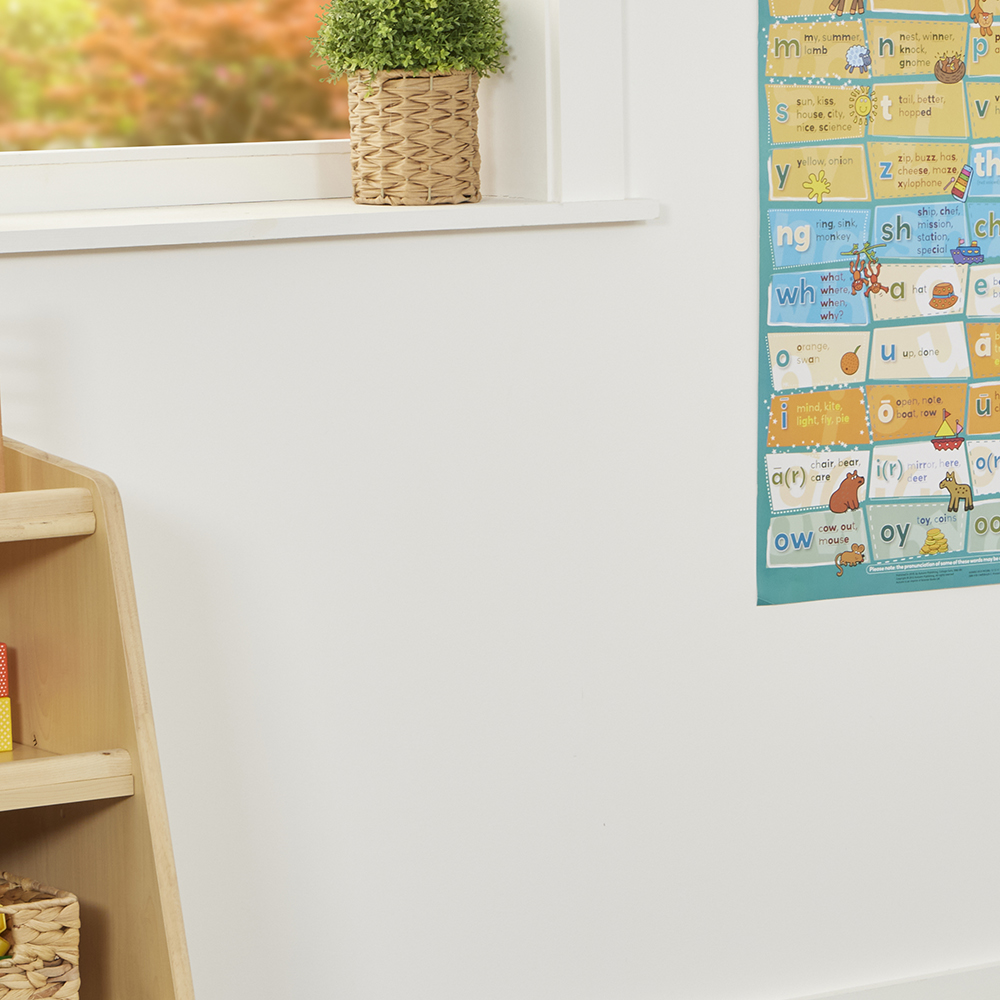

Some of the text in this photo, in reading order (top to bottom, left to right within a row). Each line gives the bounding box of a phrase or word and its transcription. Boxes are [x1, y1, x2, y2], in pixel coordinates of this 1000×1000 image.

[804, 34, 862, 42] my, summer,
[900, 33, 955, 41] nest, winner,
[774, 38, 800, 57] m
[804, 46, 828, 54] lamb
[879, 38, 894, 56] n
[900, 46, 927, 54] knock,
[973, 37, 988, 62] p
[899, 59, 930, 69] gnome
[796, 96, 836, 106] sun, kiss,
[899, 95, 946, 104] tail, better,
[776, 103, 788, 122] s
[881, 96, 892, 120] t
[899, 108, 931, 118] hopped
[975, 100, 989, 117] v
[796, 109, 845, 119] house, city,
[796, 123, 852, 132] nice, science
[797, 156, 853, 167] yellow, onion
[898, 153, 958, 163] zip, buzz, has,
[974, 151, 1000, 176] th
[880, 163, 892, 178] z
[897, 167, 931, 175] cheese,
[776, 165, 790, 189] y
[897, 179, 942, 189] xylophone
[918, 207, 960, 217] ship, chef,
[816, 219, 858, 230] ring, sink,
[882, 215, 910, 240] sh
[918, 221, 953, 229] mission,
[777, 225, 810, 251] ng
[816, 232, 851, 242] monkey
[918, 233, 949, 241] station,
[917, 245, 947, 254] special
[821, 273, 845, 282] what,
[776, 279, 815, 305] wh
[891, 283, 904, 299] a
[913, 286, 927, 294] hat
[975, 279, 987, 295] e
[821, 299, 847, 308] when,
[821, 311, 844, 320] why?
[797, 343, 830, 352] orange,
[881, 345, 895, 360] u
[903, 348, 939, 358] up, done
[776, 350, 790, 367] o
[797, 356, 820, 364] swan
[896, 396, 943, 406] open, note,
[797, 402, 842, 412] mind, kite,
[897, 409, 937, 419] boat, row
[797, 415, 849, 427] light, fly, pie
[811, 459, 860, 469] chair, bear,
[907, 459, 961, 469] mirror, here,
[876, 459, 902, 481] i(r)
[811, 474, 831, 482] care
[907, 474, 927, 482] deer
[917, 514, 957, 525] toy, coins
[819, 522, 858, 532] cow, out,
[881, 523, 910, 547] oy
[775, 532, 813, 551] ow
[819, 536, 849, 545] mouse
